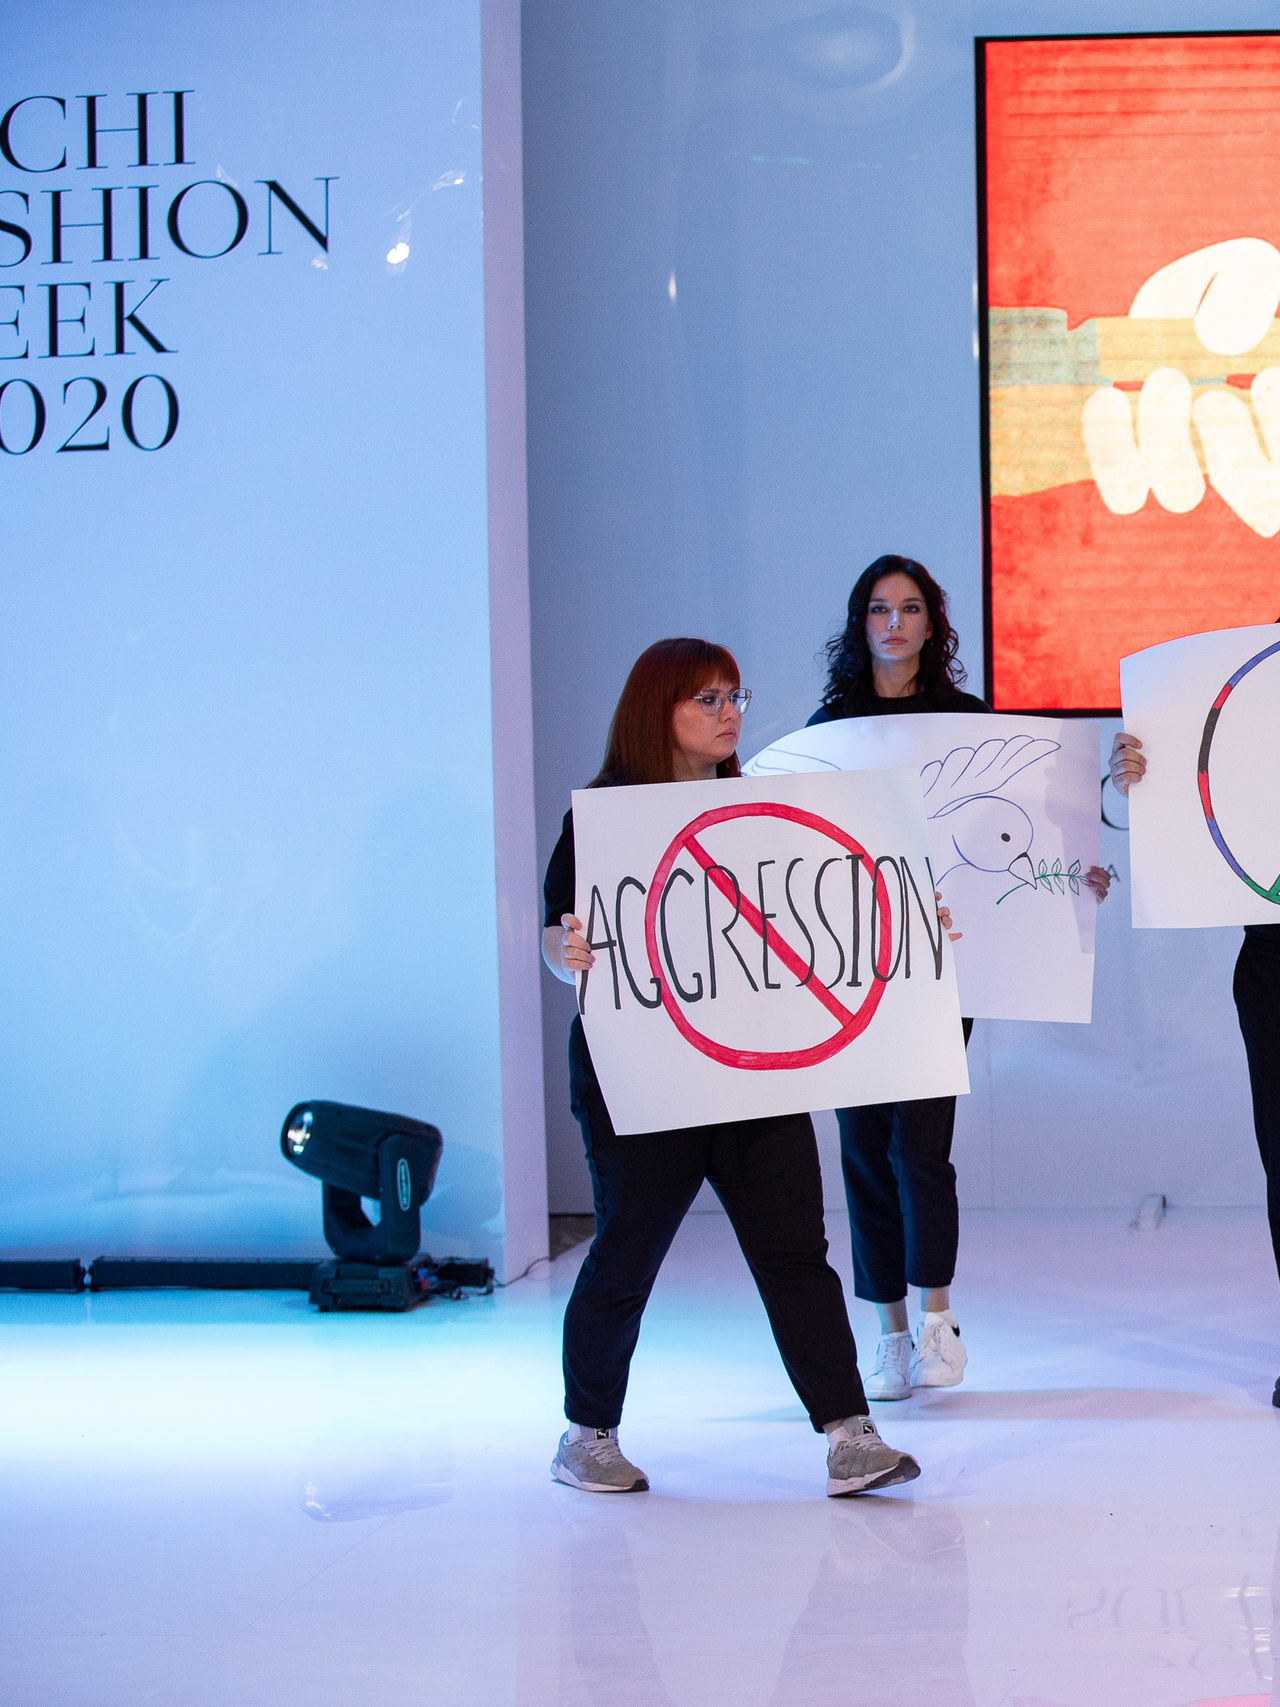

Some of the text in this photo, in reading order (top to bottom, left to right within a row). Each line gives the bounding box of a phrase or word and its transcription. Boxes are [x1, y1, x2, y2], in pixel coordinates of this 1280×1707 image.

[0, 89, 196, 173] CHI
[0, 176, 340, 268] SHION
[0, 373, 181, 456] 020
[577, 853, 944, 1016] AGGRESSION
